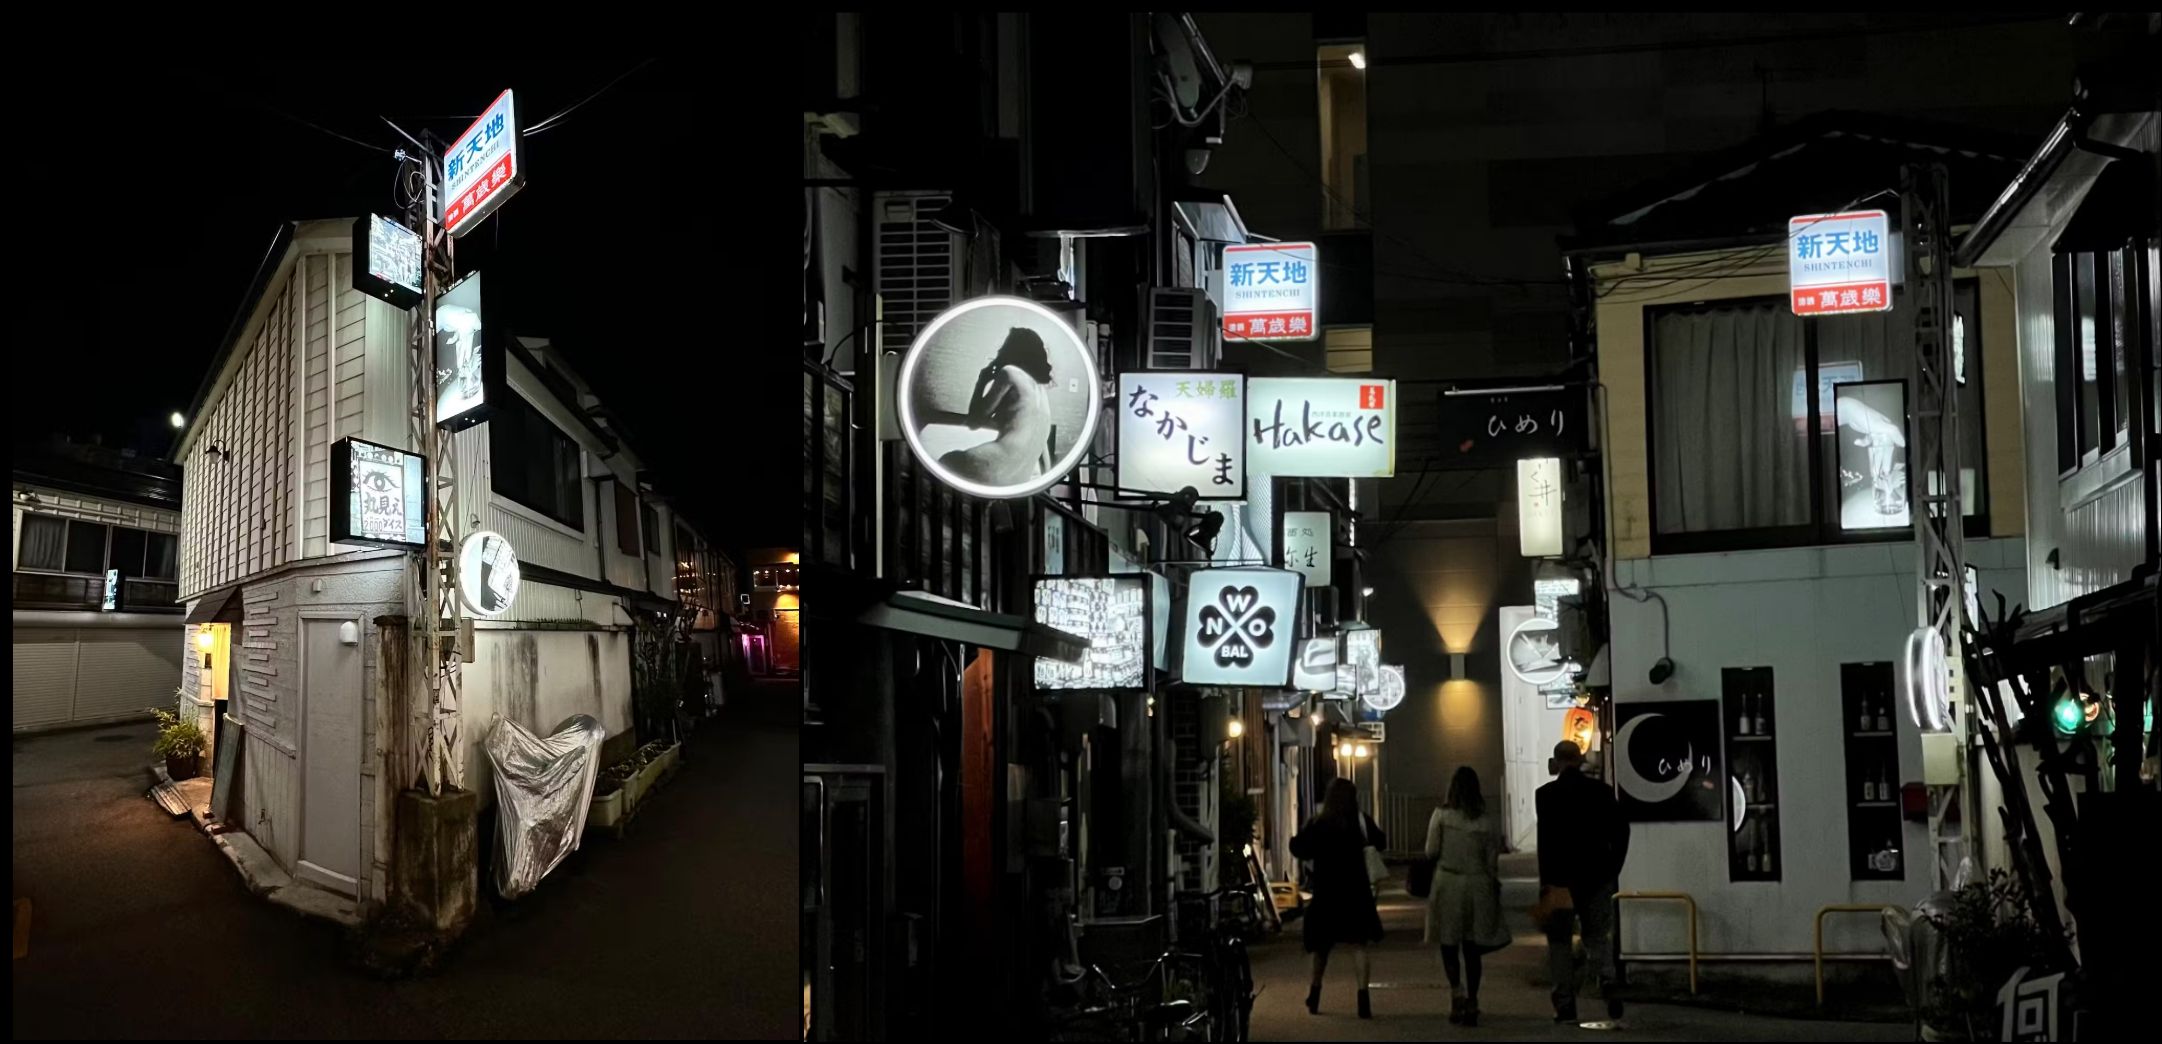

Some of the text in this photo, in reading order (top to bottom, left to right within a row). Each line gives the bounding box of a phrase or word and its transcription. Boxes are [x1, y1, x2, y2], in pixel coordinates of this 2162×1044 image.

[448, 112, 504, 181] 新天地
[450, 140, 500, 191] SHINTENCHI
[1797, 230, 1879, 259] 新天地
[1230, 261, 1307, 287] 新天地
[1804, 259, 1872, 272] SHINTENCHI
[1235, 288, 1300, 299] SHINTENCHI
[1128, 384, 1235, 485] なかじま
[1253, 399, 1384, 450] Hakase
[1488, 409, 1564, 437] ひめり
[364, 492, 403, 516] 丸見え
[1226, 594, 1252, 613] W
[1206, 617, 1267, 637] N O
[1221, 645, 1249, 658] BAL
